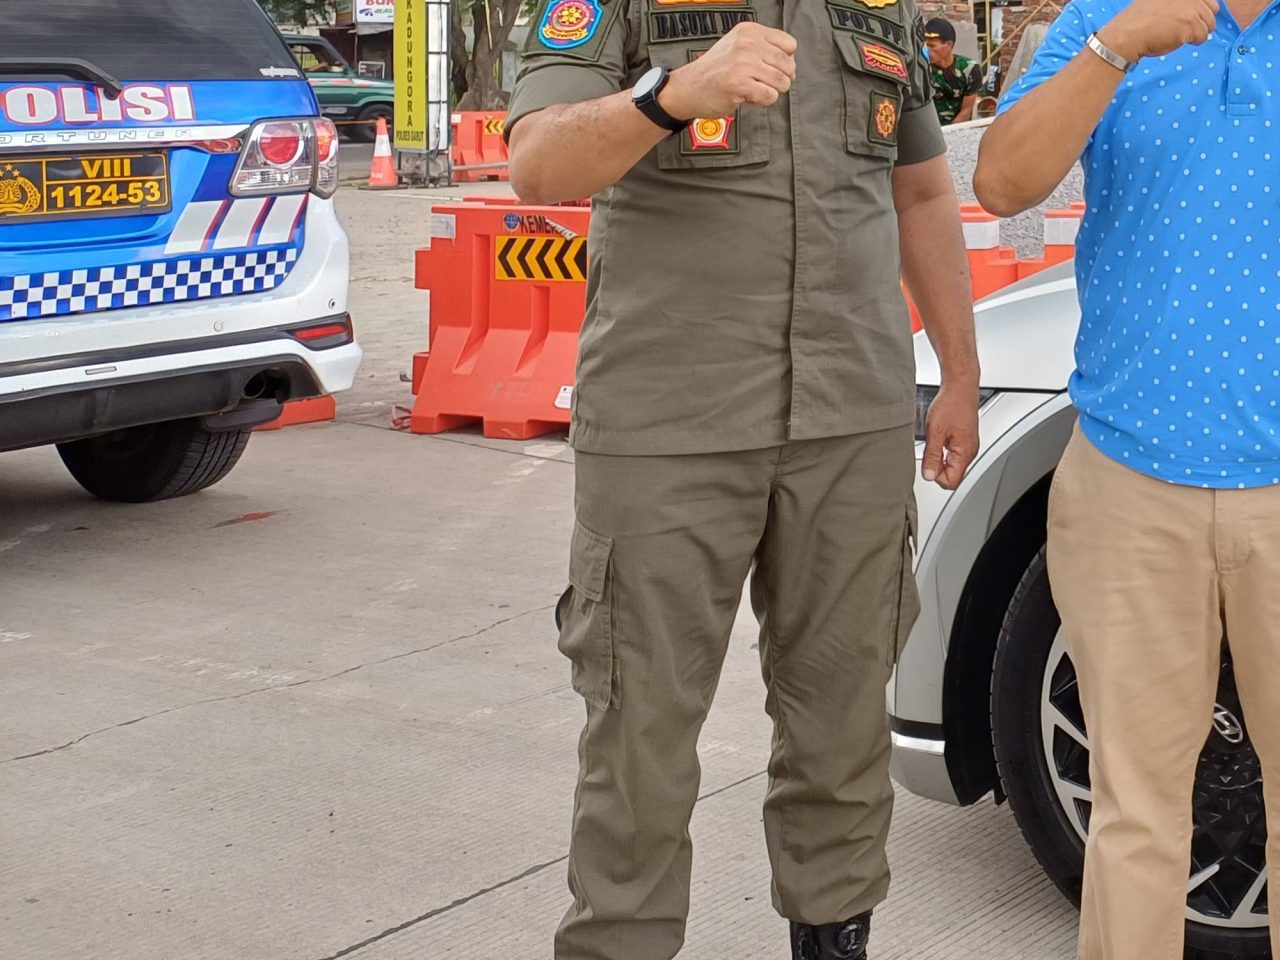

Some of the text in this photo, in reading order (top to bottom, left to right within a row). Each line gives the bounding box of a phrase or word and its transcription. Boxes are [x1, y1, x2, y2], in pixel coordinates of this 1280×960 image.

[655, 11, 718, 38] BASUKI
[836, 9, 901, 45] POL PP
[0, 85, 194, 124] OLISI
[0, 128, 192, 144] ORTUNER
[81, 158, 131, 179] VIII
[51, 181, 161, 208] 1124-53
